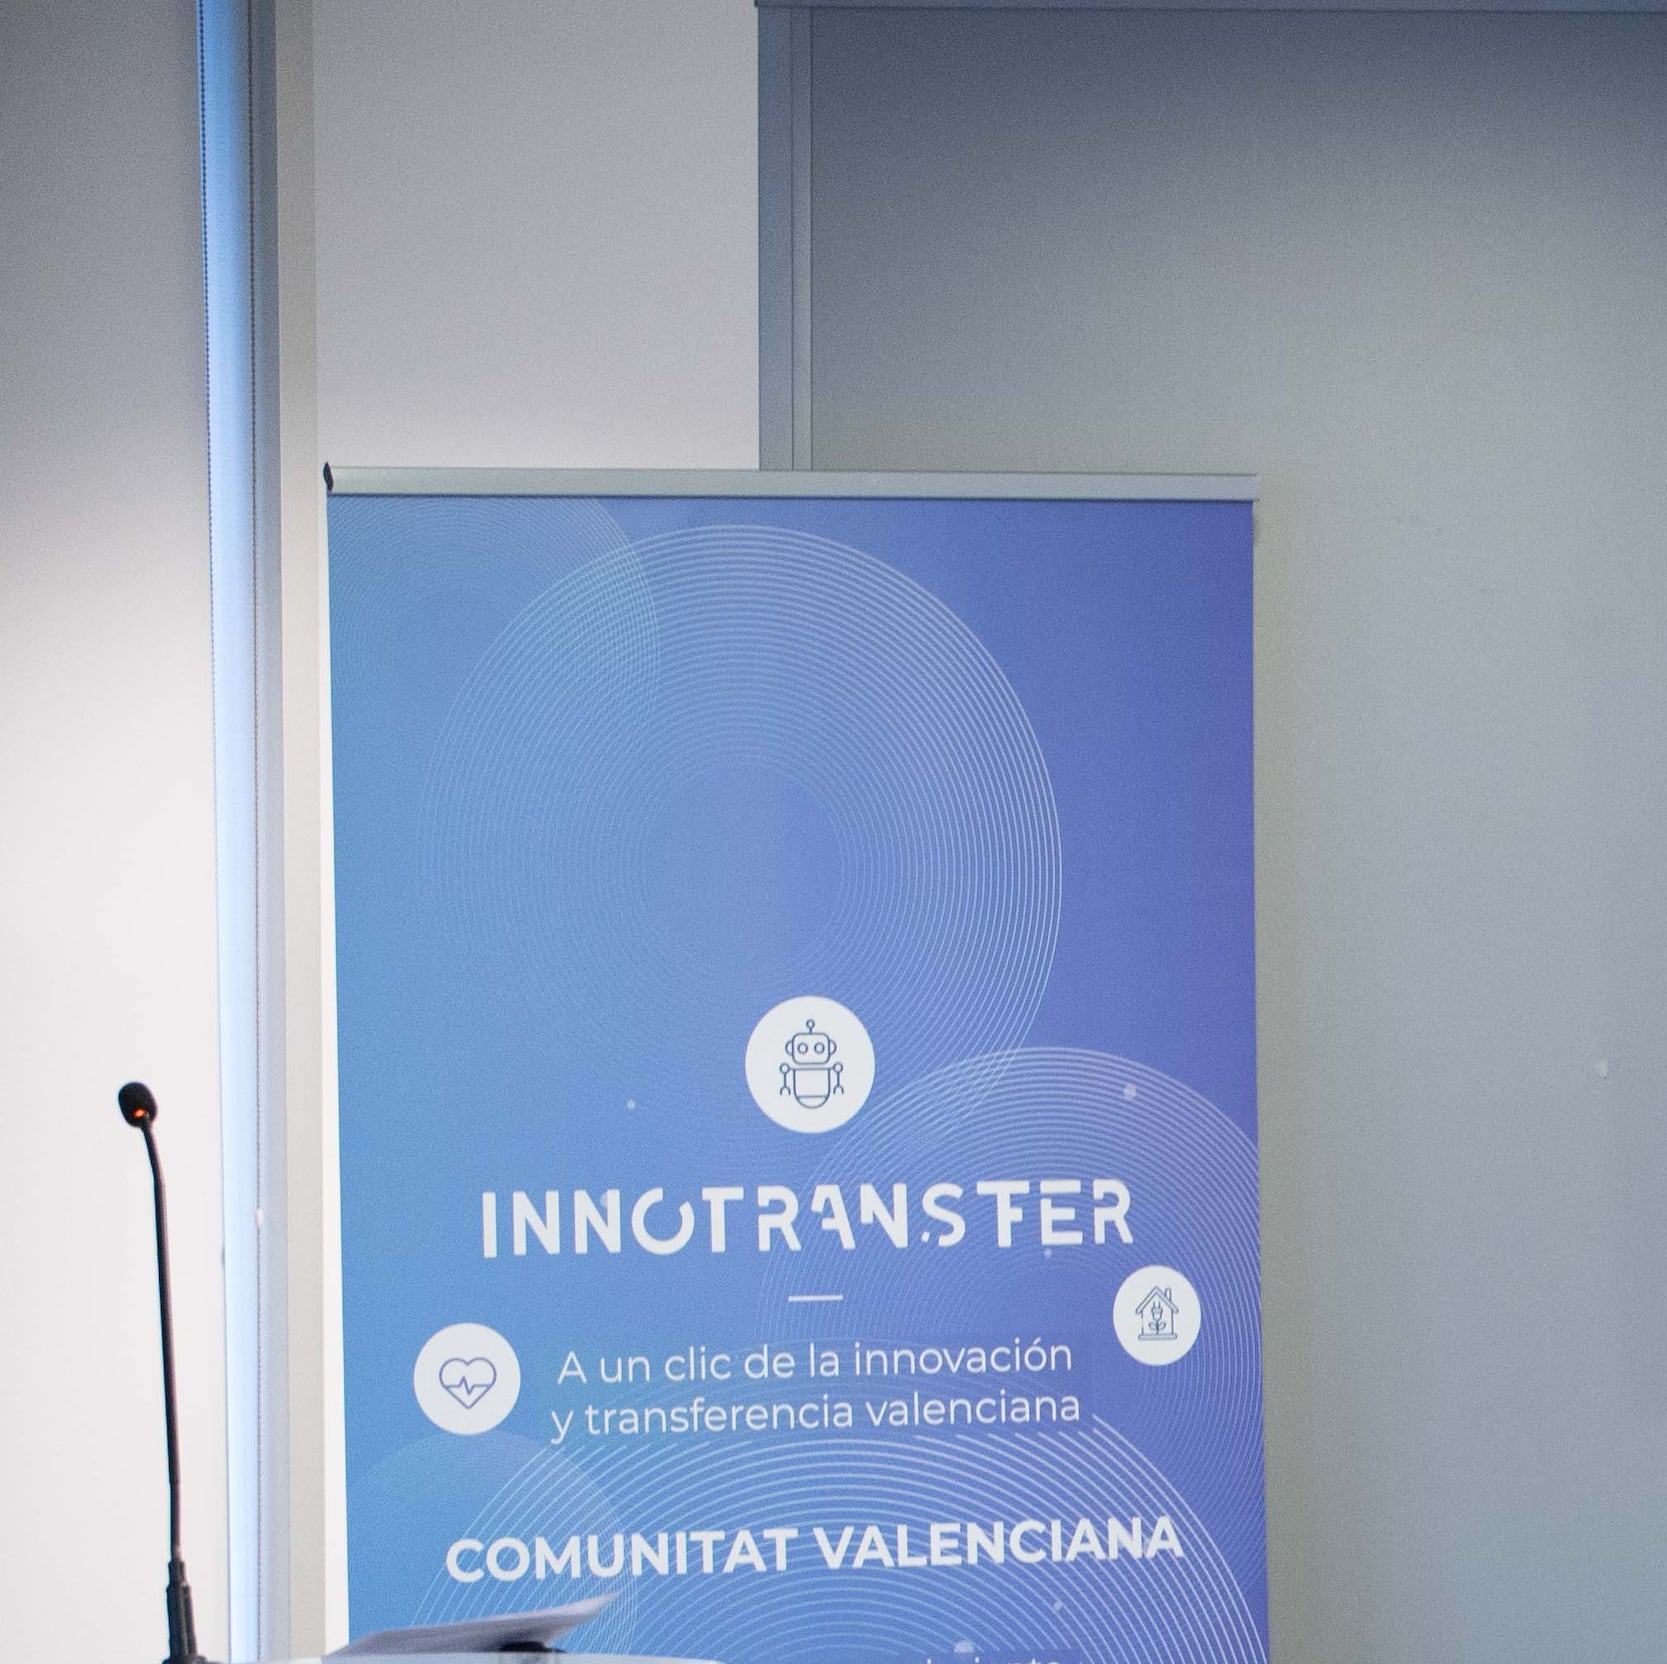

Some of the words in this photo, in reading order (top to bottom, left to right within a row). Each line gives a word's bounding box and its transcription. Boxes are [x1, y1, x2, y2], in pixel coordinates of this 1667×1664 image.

[557, 1350, 587, 1385] A
[599, 1354, 651, 1383] un
[663, 1345, 732, 1382] clic
[743, 1343, 796, 1380] de
[808, 1341, 841, 1378] la
[854, 1337, 1073, 1377] innovación
[550, 1409, 574, 1445] y
[584, 1392, 854, 1435] transferencia
[865, 1388, 1081, 1428] valenciana
[445, 1527, 798, 1583] COMUNITAT
[813, 1515, 1185, 1571] VALENCIANA
